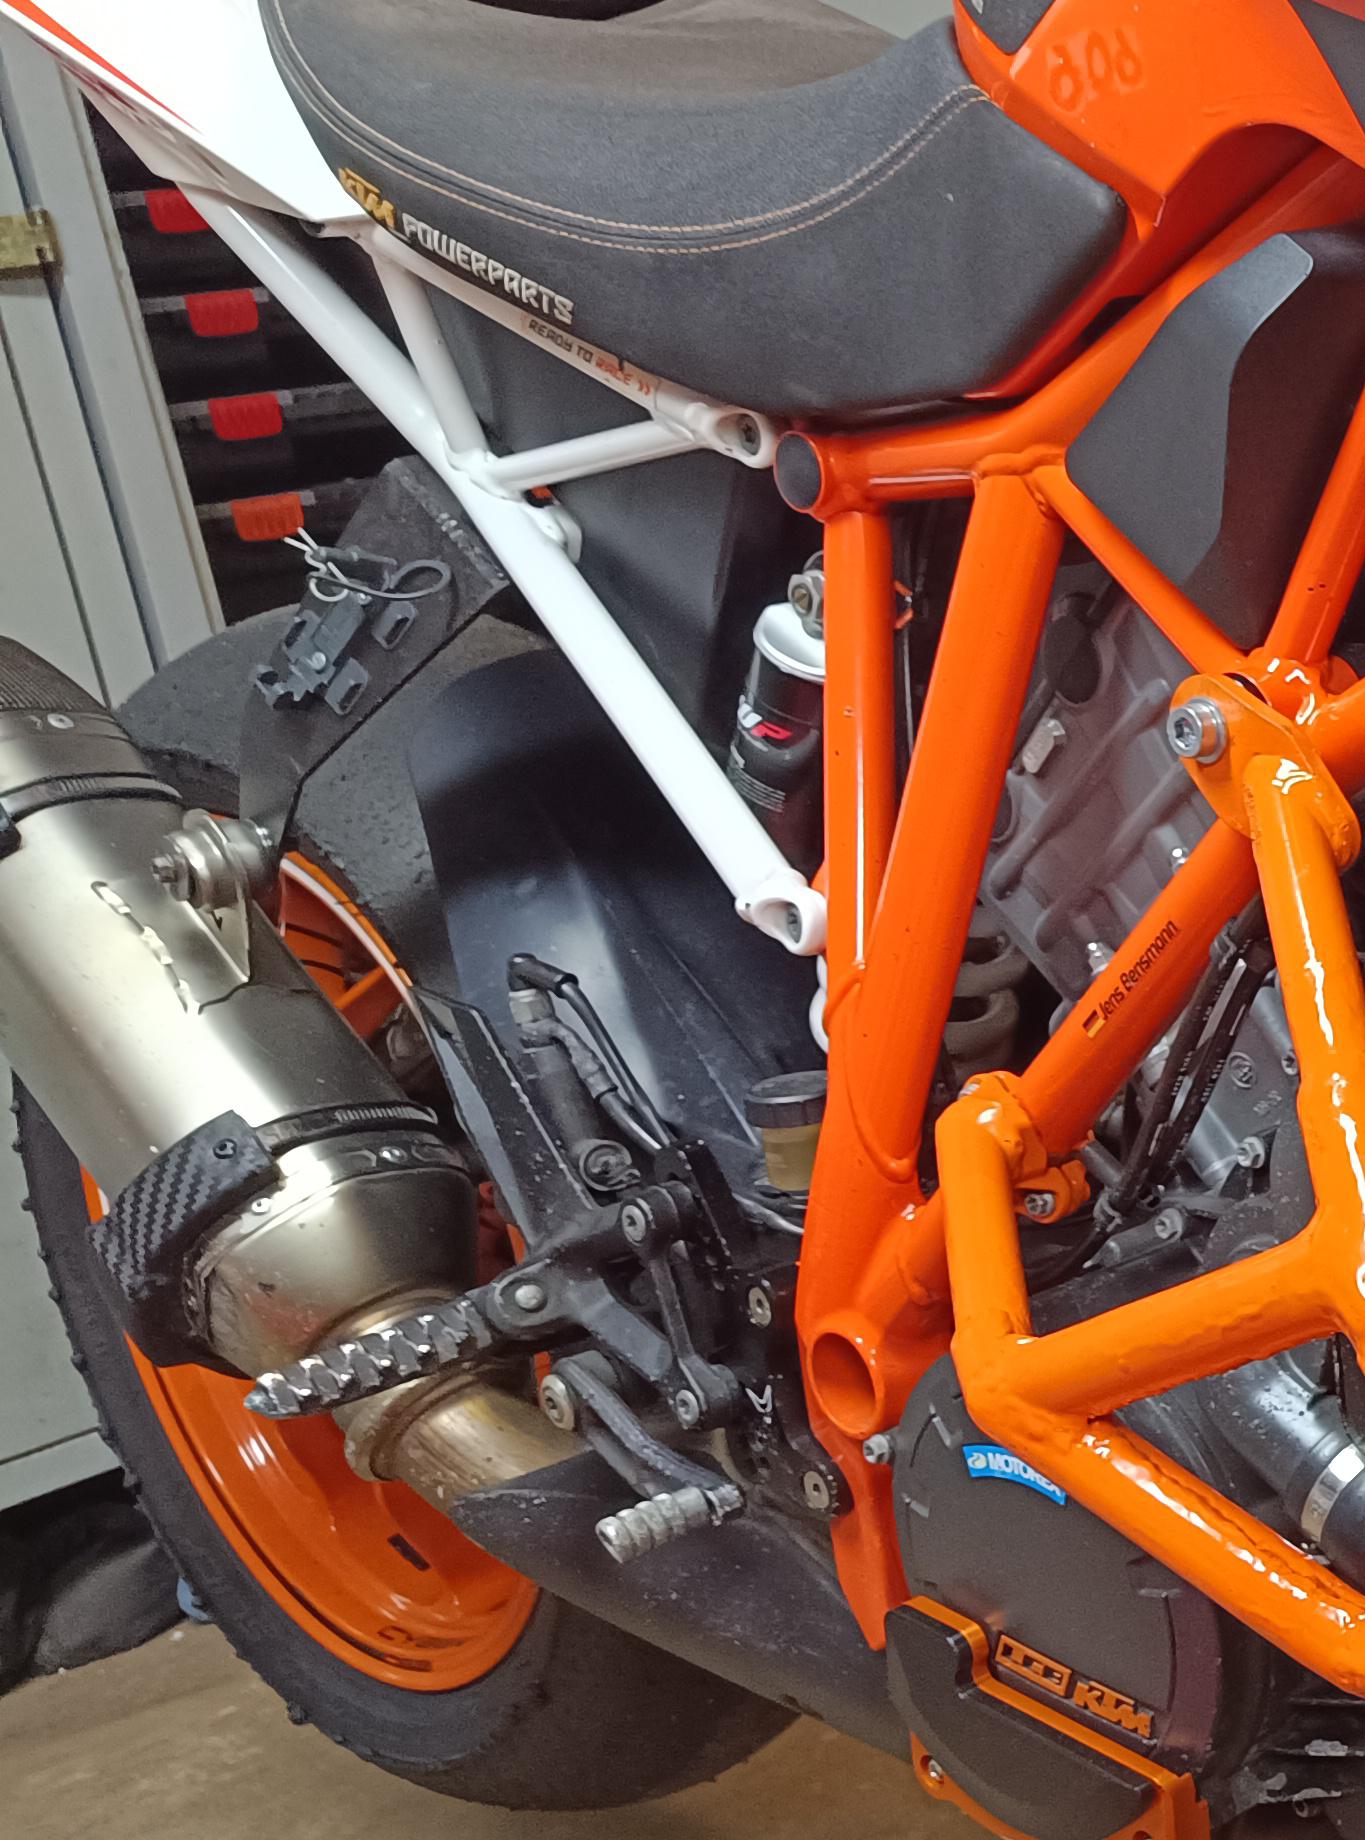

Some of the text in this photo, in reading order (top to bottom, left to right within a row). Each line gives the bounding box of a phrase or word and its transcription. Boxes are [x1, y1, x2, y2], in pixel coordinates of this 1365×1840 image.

[402, 212, 575, 325] POWERPARTS
[529, 319, 573, 353] READY
[575, 344, 595, 364] TO
[1098, 920, 1181, 1021] Jens Bensmann
[1072, 1681, 1153, 1739] KTM
